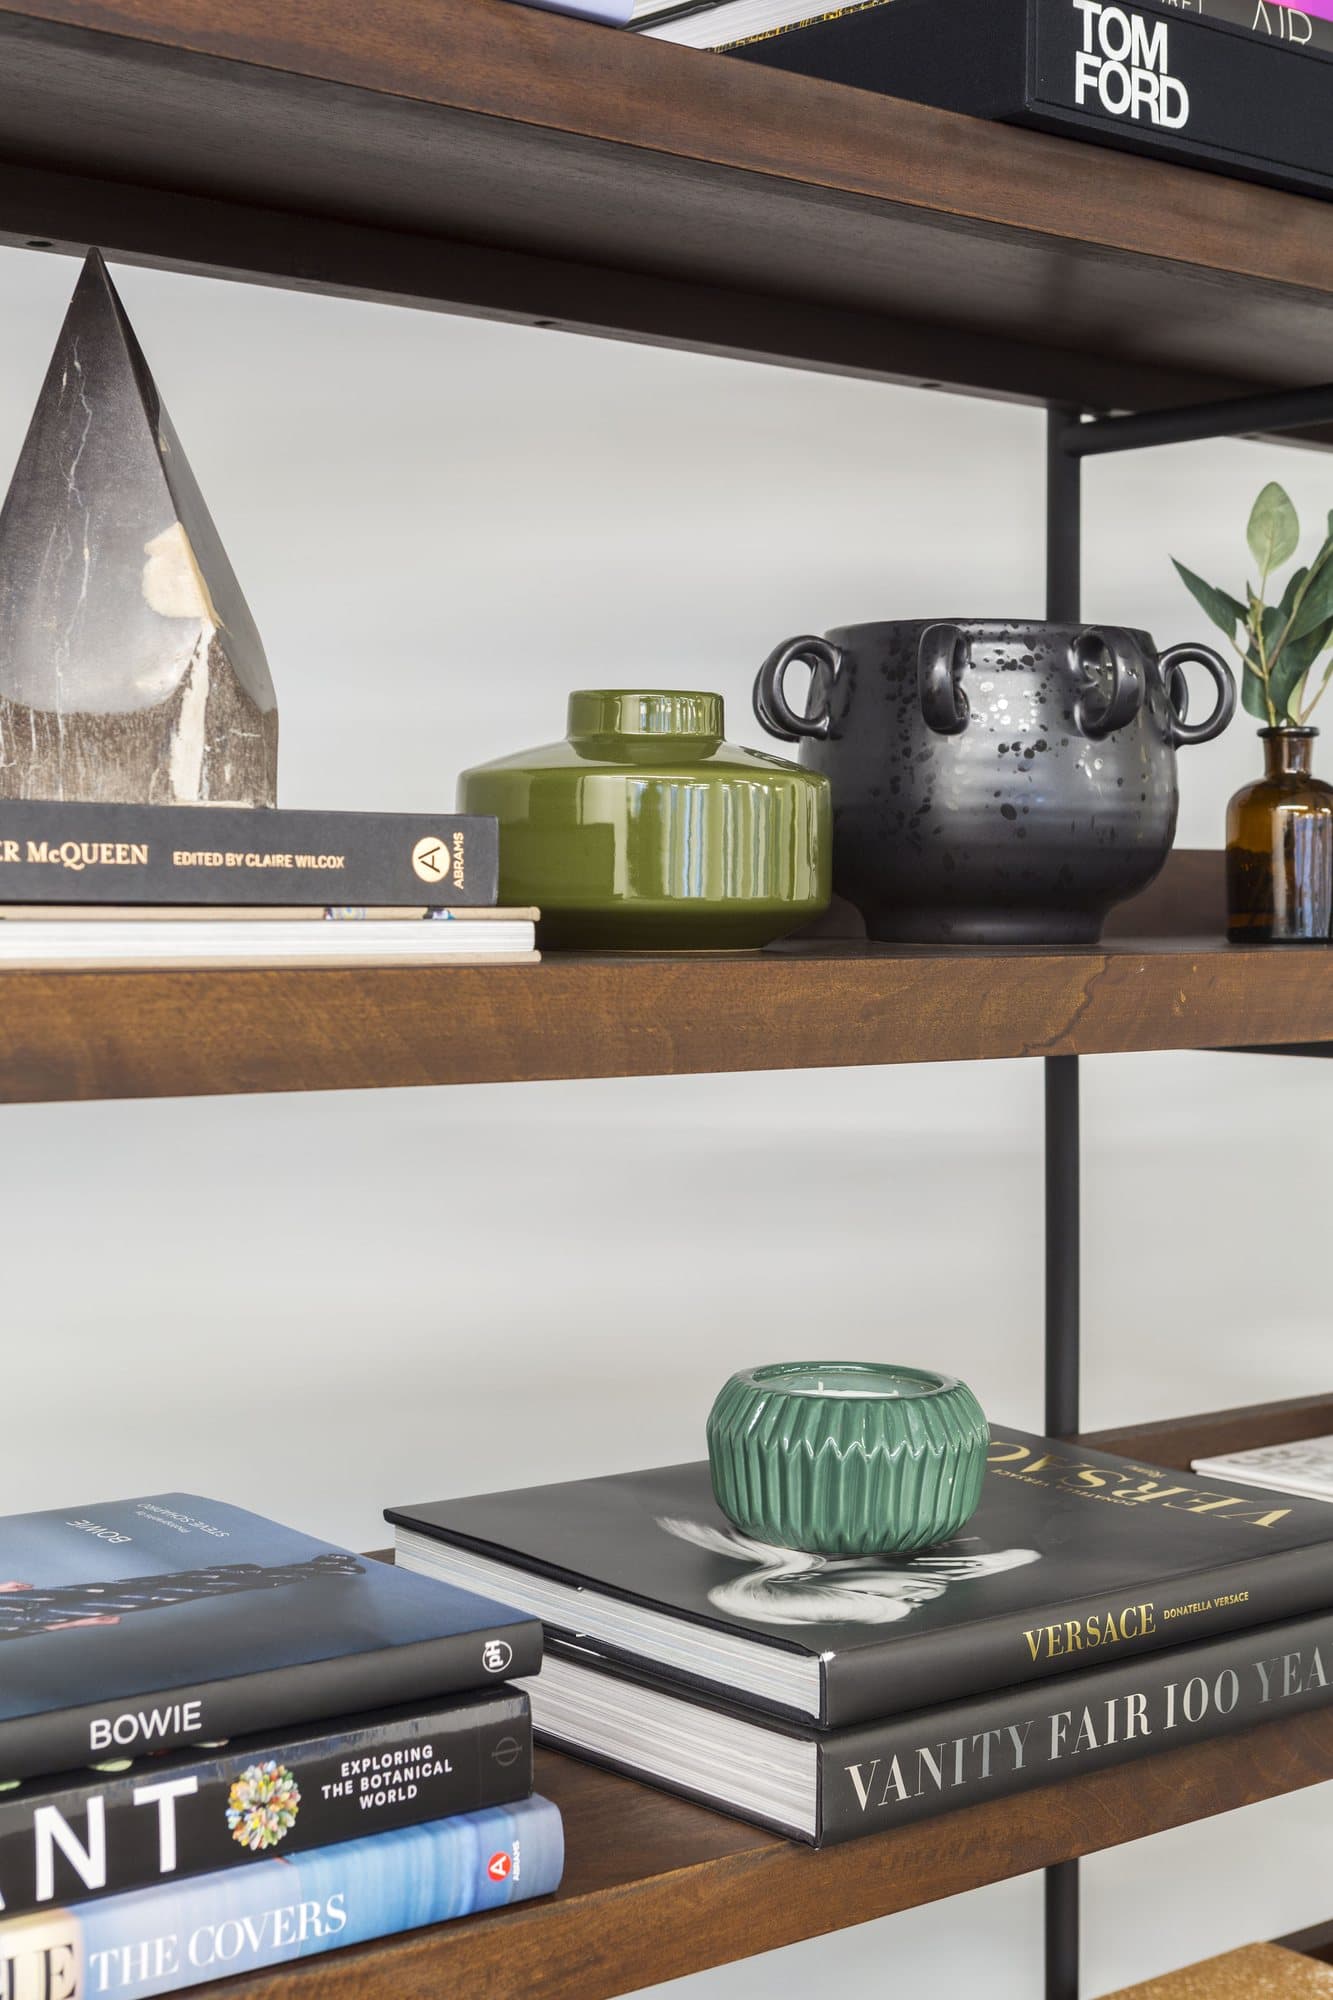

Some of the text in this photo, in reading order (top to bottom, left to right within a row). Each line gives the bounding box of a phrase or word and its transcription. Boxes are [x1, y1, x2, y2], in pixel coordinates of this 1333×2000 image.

[1072, 0, 1168, 75] TOM
[1075, 51, 1189, 129] FORD
[0, 840, 345, 870] R McQUEEN EDITED BY CLAIRE WILCOX
[452, 832, 465, 889] ABRAMS
[986, 1441, 1293, 1529] VERSAC
[65, 1518, 132, 1544] BOWIE
[1022, 1591, 1249, 1662] VERSACE DONATELLA VERSACE
[90, 1701, 203, 1751] BOWIE
[844, 1720, 1035, 1812] VANITY
[1048, 1693, 1152, 1761] FAIR
[1251, 1642, 1333, 1704] YEA
[321, 1759, 453, 1801] THE BOTANICAL
[341, 1744, 434, 1778] EXPLORING
[359, 1784, 418, 1811] WORLD
[0, 1775, 199, 1911] NT
[89, 1935, 180, 1992] THE
[188, 1893, 348, 1967] COVERS
